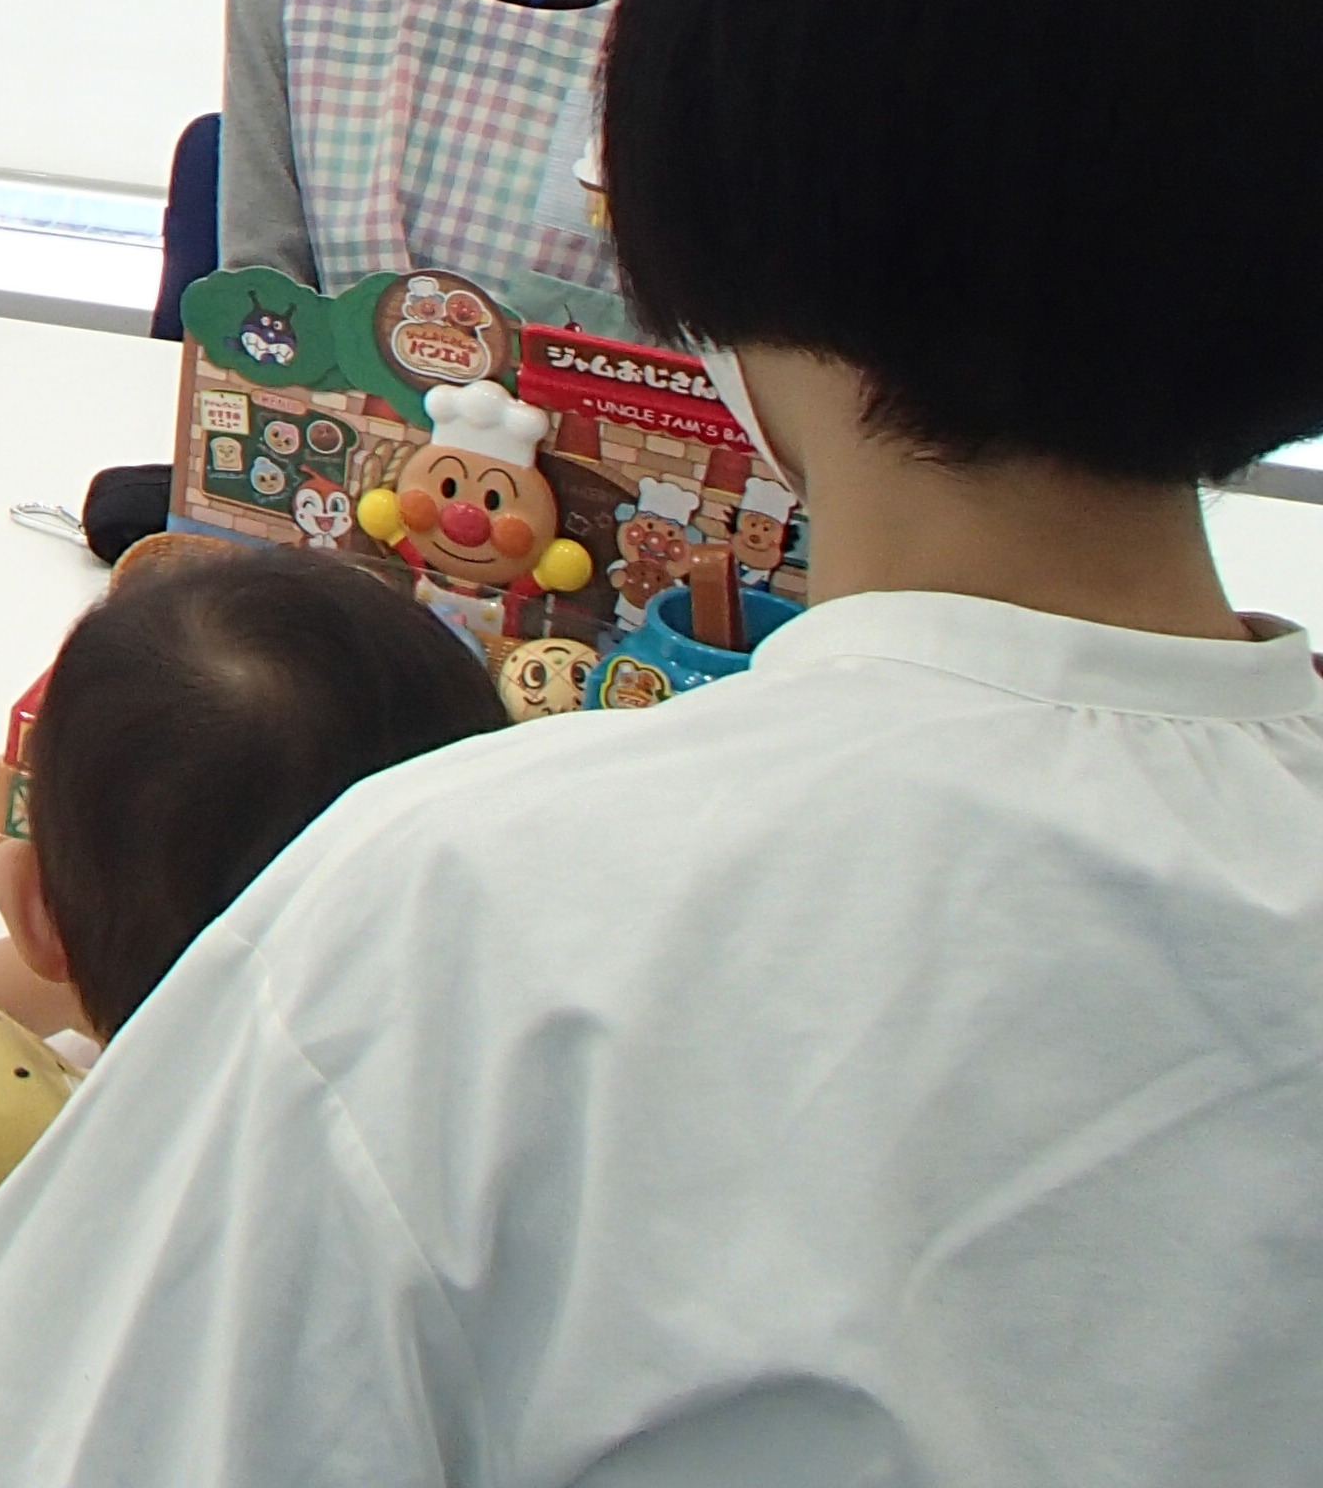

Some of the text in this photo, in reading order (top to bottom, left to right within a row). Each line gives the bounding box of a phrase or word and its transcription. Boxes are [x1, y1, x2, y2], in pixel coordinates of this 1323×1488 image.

[596, 398, 751, 446] UNCLE JAM'S BA
